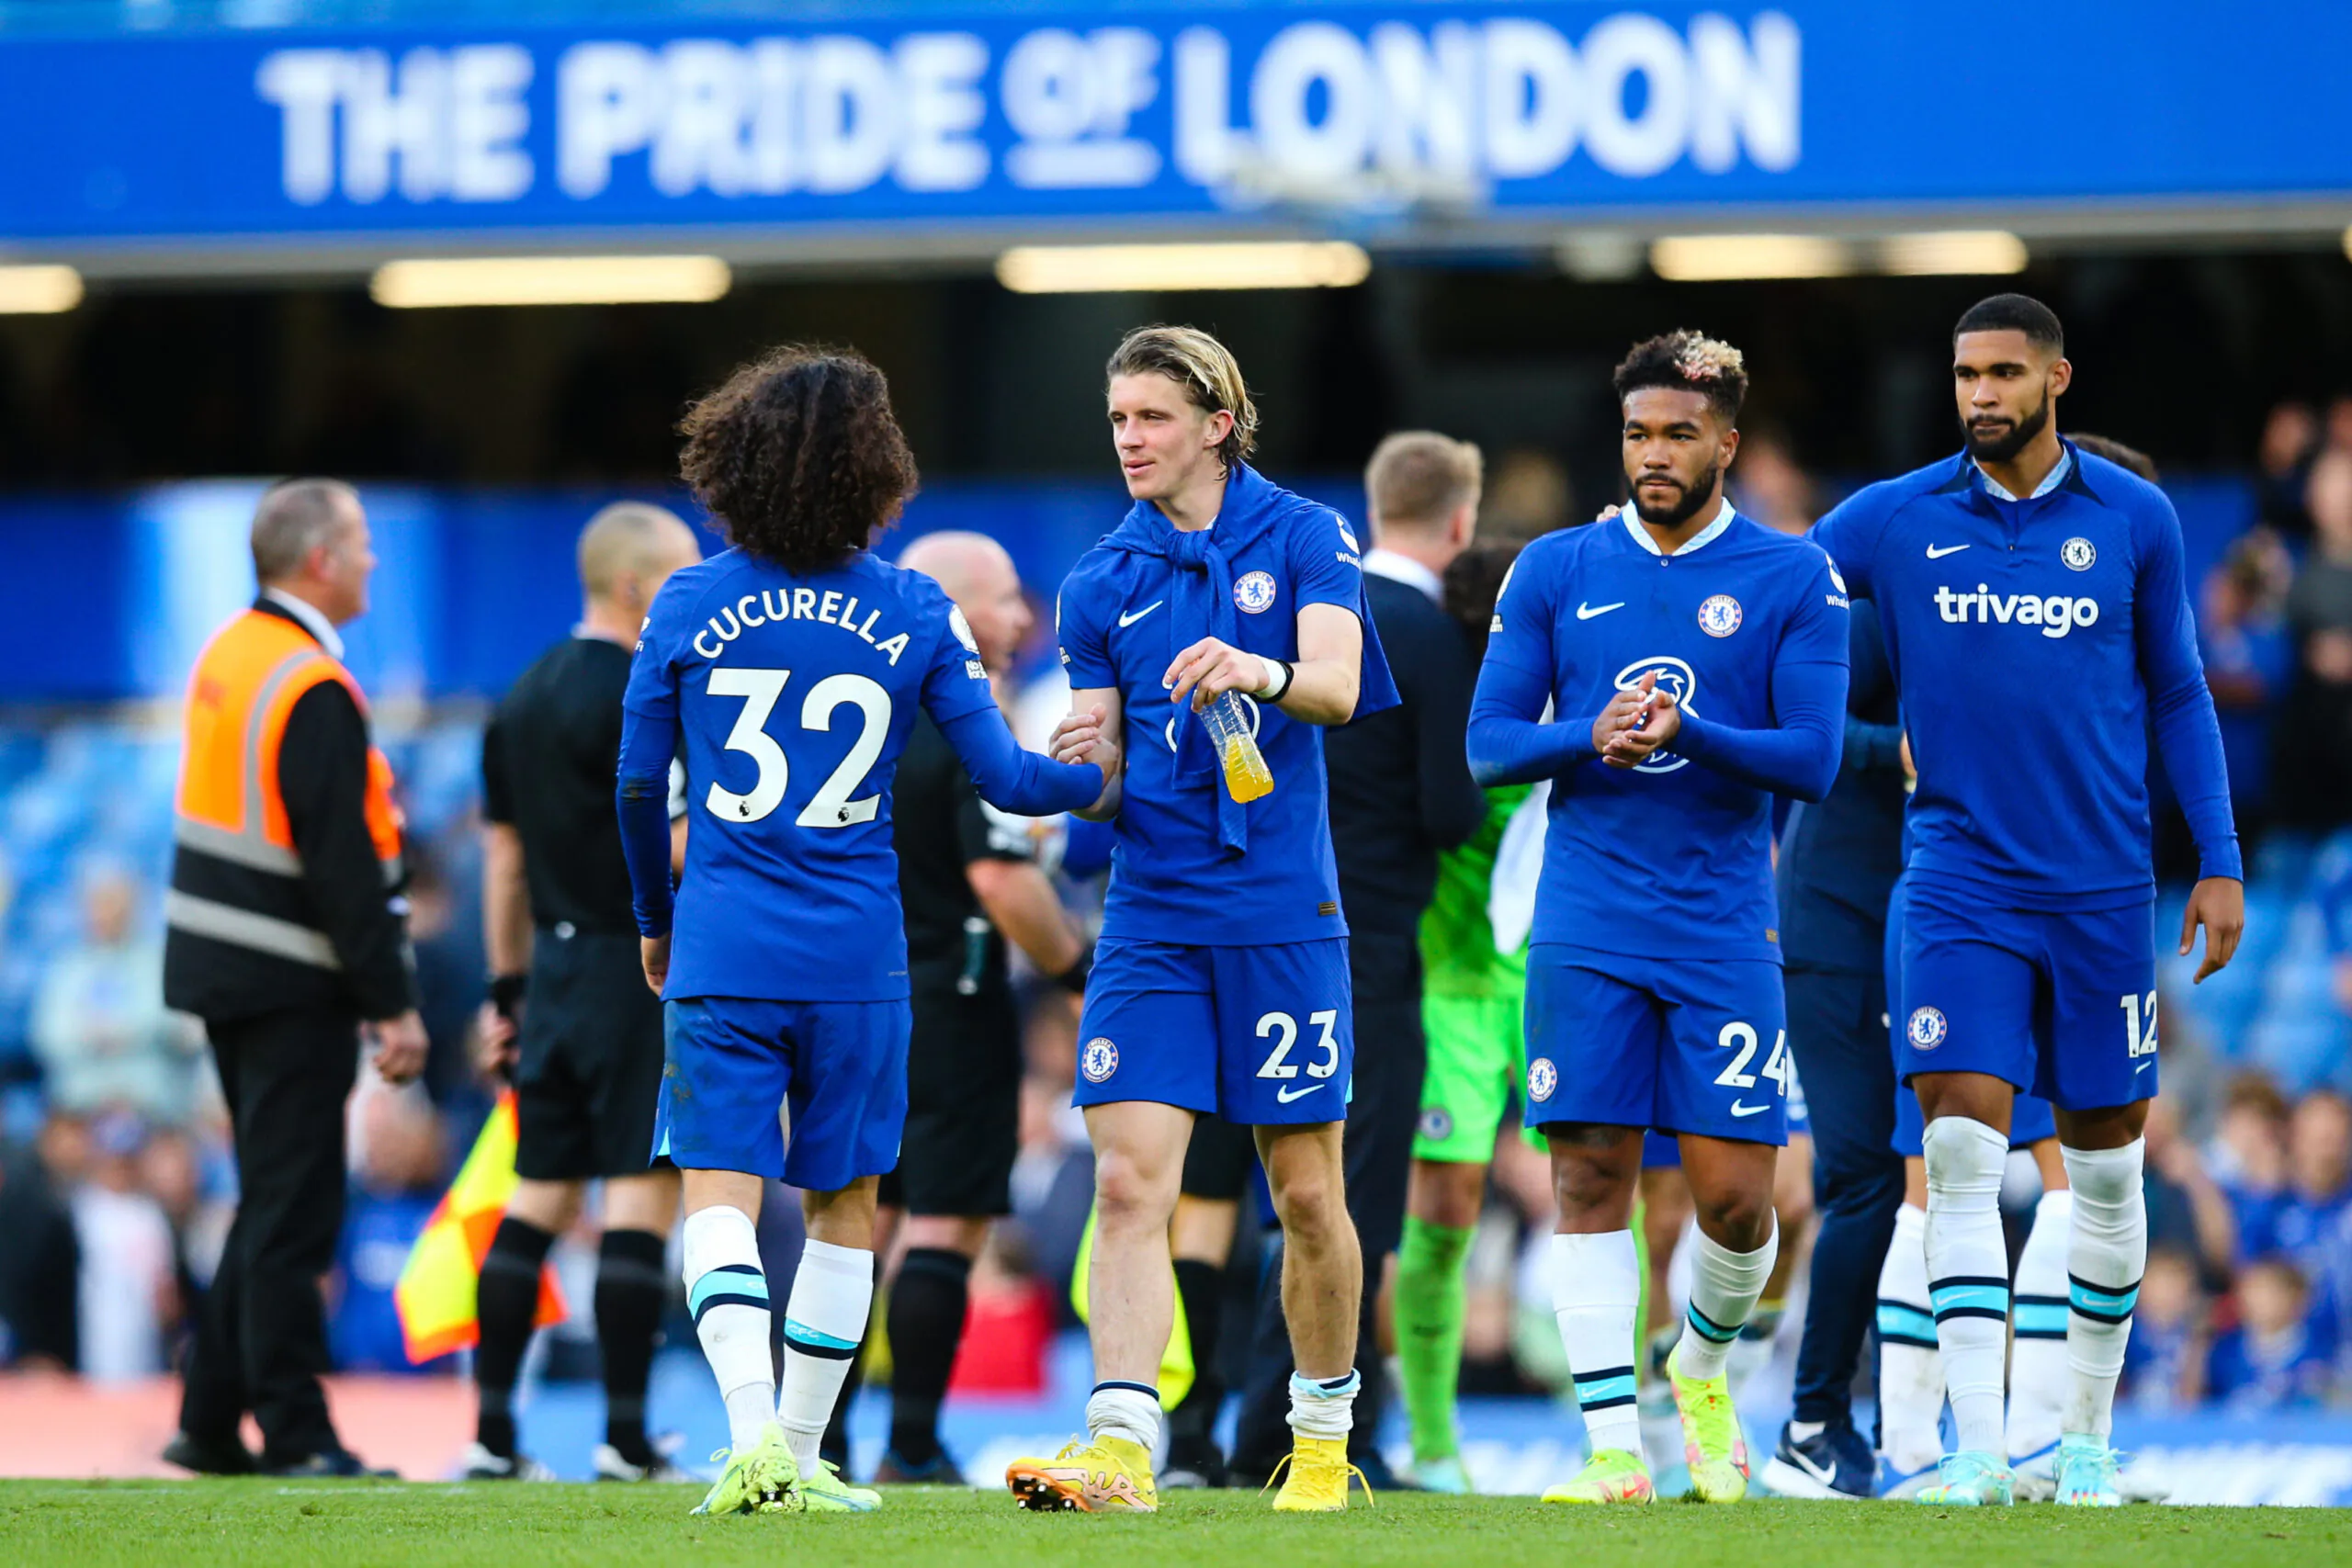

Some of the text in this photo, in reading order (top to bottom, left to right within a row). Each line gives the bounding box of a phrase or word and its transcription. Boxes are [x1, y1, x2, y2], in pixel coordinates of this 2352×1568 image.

[257, 11, 1801, 205] THE PRIDE OF LONDON
[694, 589, 910, 666] CUCURELLA
[1934, 583, 2099, 638] trivago
[706, 668, 892, 829] 32
[1255, 1009, 1340, 1079] 23
[1713, 1021, 1787, 1097] 24
[2120, 989, 2157, 1058] 12
